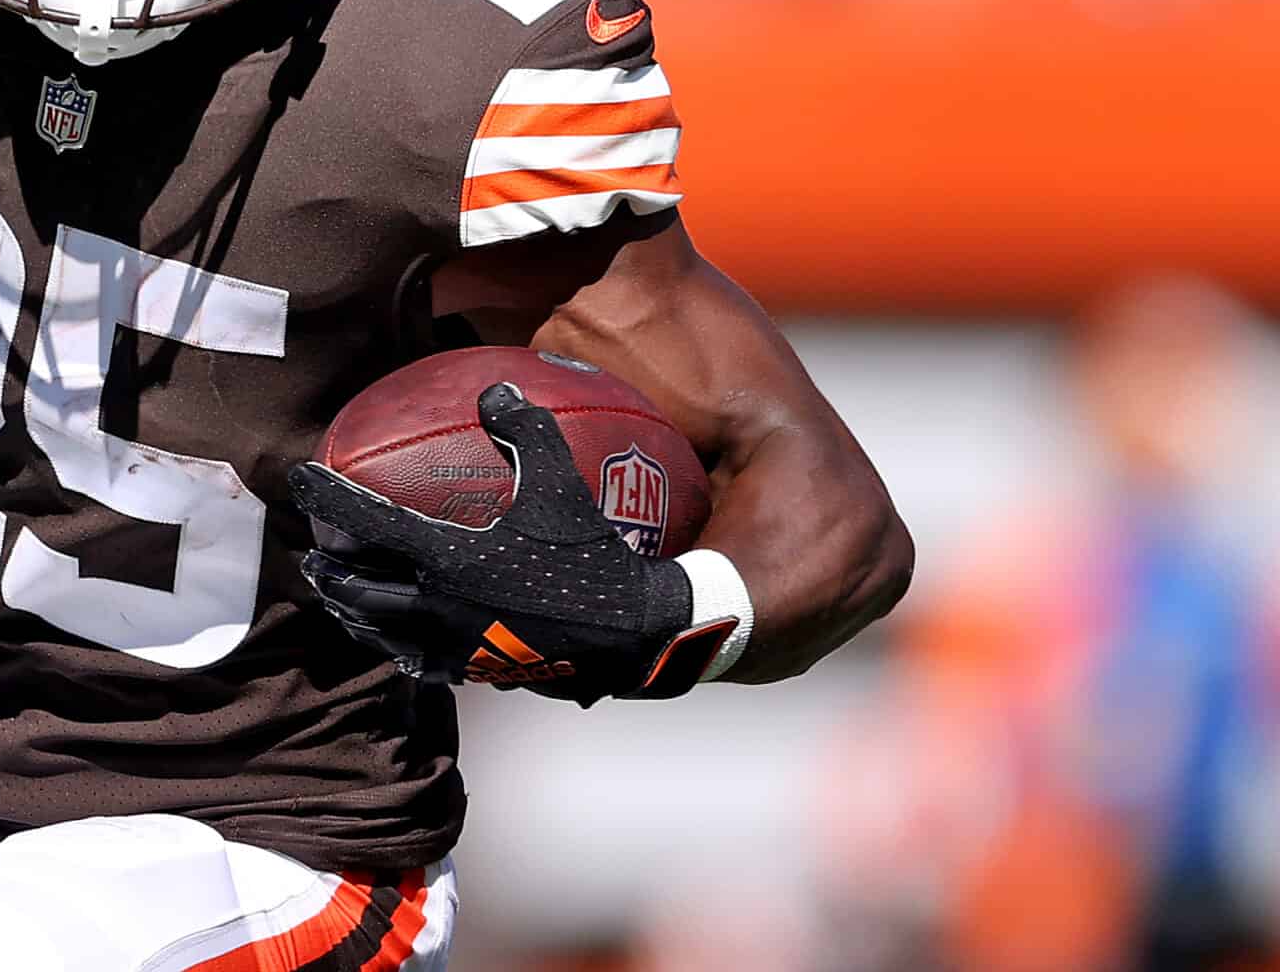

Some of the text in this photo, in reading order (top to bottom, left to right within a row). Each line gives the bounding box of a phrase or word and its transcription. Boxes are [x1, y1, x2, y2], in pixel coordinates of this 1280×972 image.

[44, 106, 80, 140] NFL
[609, 461, 662, 525] NFL
[463, 660, 577, 685] adidas
